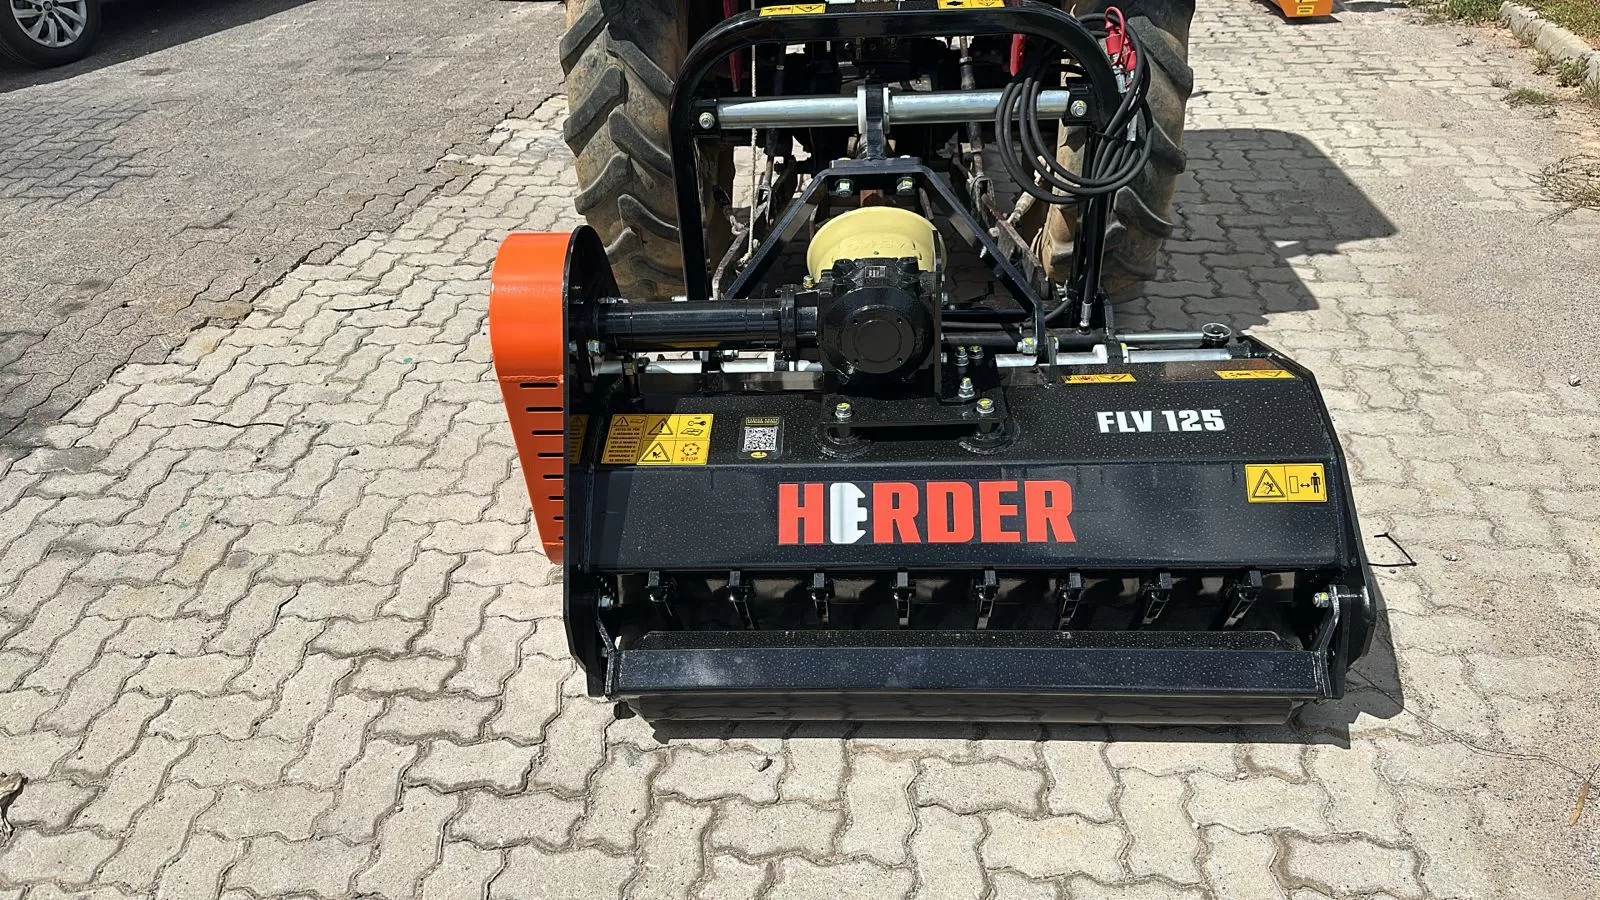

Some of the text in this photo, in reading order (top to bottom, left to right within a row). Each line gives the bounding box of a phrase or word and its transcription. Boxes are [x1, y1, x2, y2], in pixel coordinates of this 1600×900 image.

[1097, 409, 1226, 433] FLV 125
[778, 480, 1077, 545] HERDER
